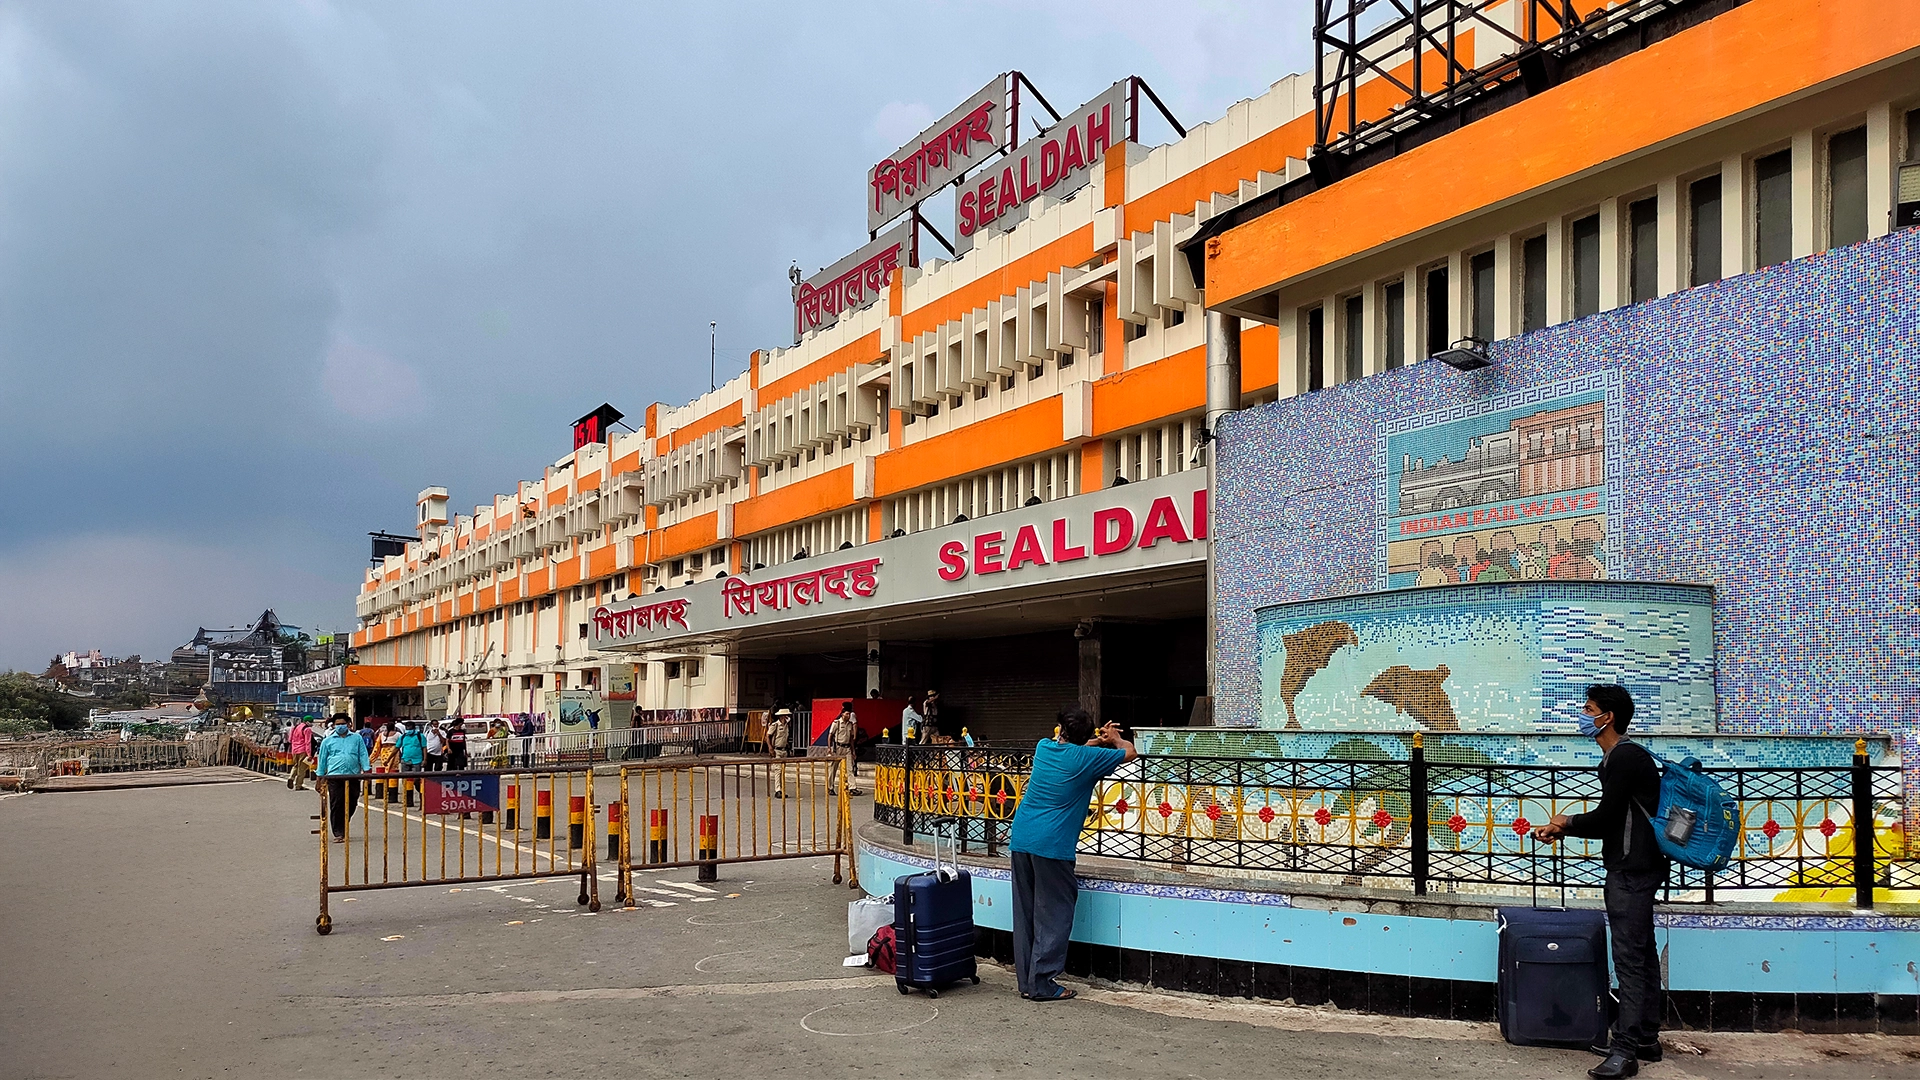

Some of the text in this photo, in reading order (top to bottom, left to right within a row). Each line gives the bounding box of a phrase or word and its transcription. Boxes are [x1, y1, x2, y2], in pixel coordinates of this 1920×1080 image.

[871, 100, 997, 214] শিয়ালদহ
[959, 102, 1111, 236] SEALDAH
[796, 242, 901, 334] सियालदह
[1400, 491, 1598, 535] INDIAN RAILWAYS
[720, 557, 883, 618] सियालदह
[592, 598, 691, 641] শিয়ালদহ
[441, 779, 482, 798] RPF
[441, 799, 477, 811] SDAH
